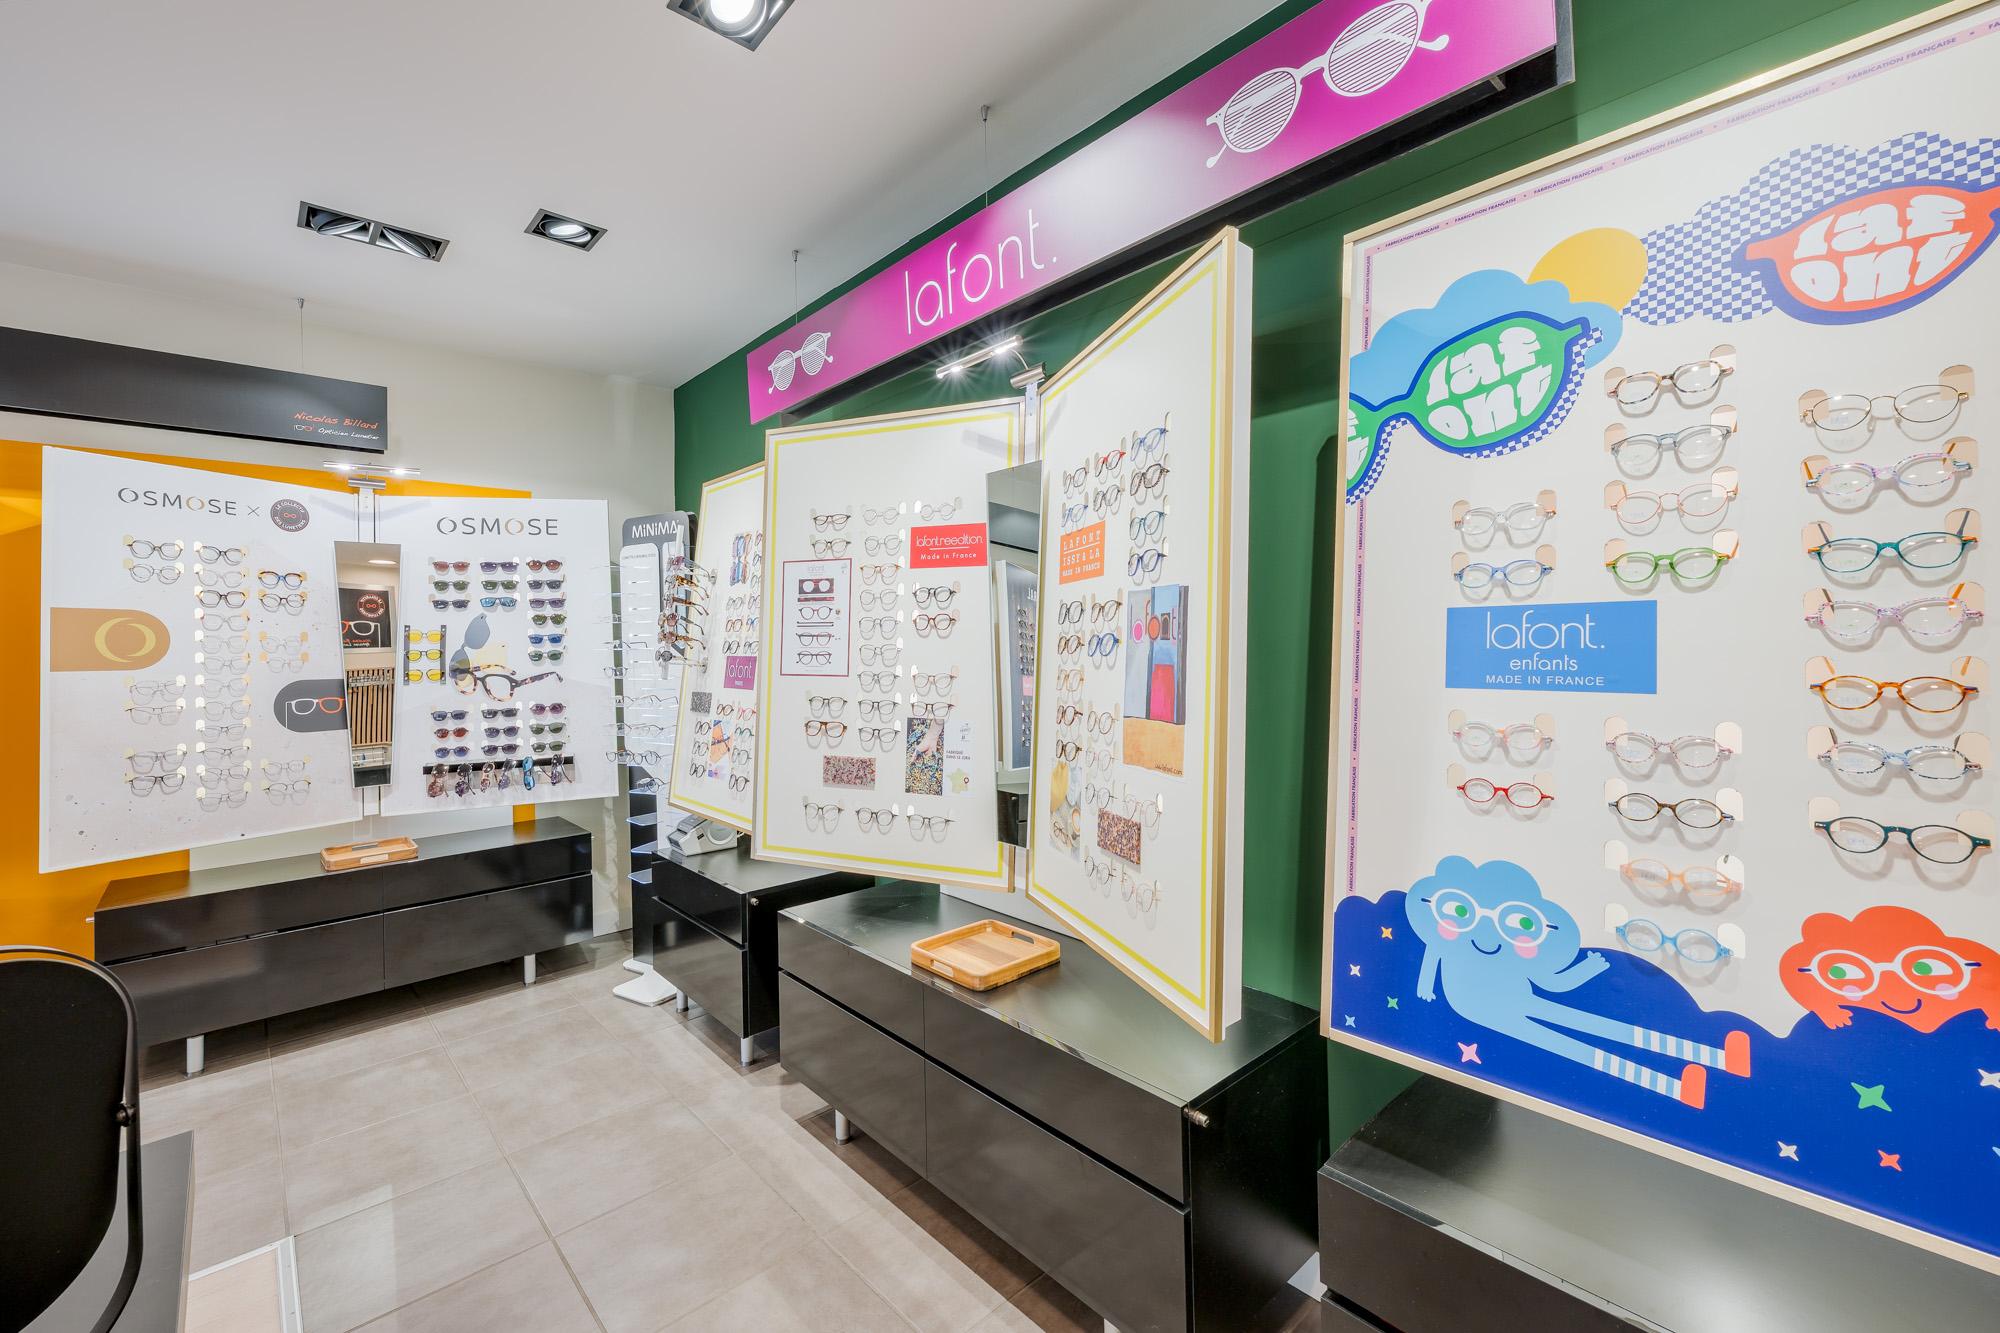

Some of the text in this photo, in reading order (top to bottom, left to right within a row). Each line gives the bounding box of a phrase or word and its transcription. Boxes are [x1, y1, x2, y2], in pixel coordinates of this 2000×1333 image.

[1847, 56, 1904, 80] FABRICATION
[294, 411, 379, 430] Nicolas Billard
[318, 428, 348, 436] Opticien
[118, 487, 237, 516] OSMOSE
[436, 516, 558, 536] OSMOSE
[1486, 609, 1605, 650] lafont.
[1510, 652, 1578, 672] enfants
[1486, 674, 1605, 686] MADE IN FRANCE
